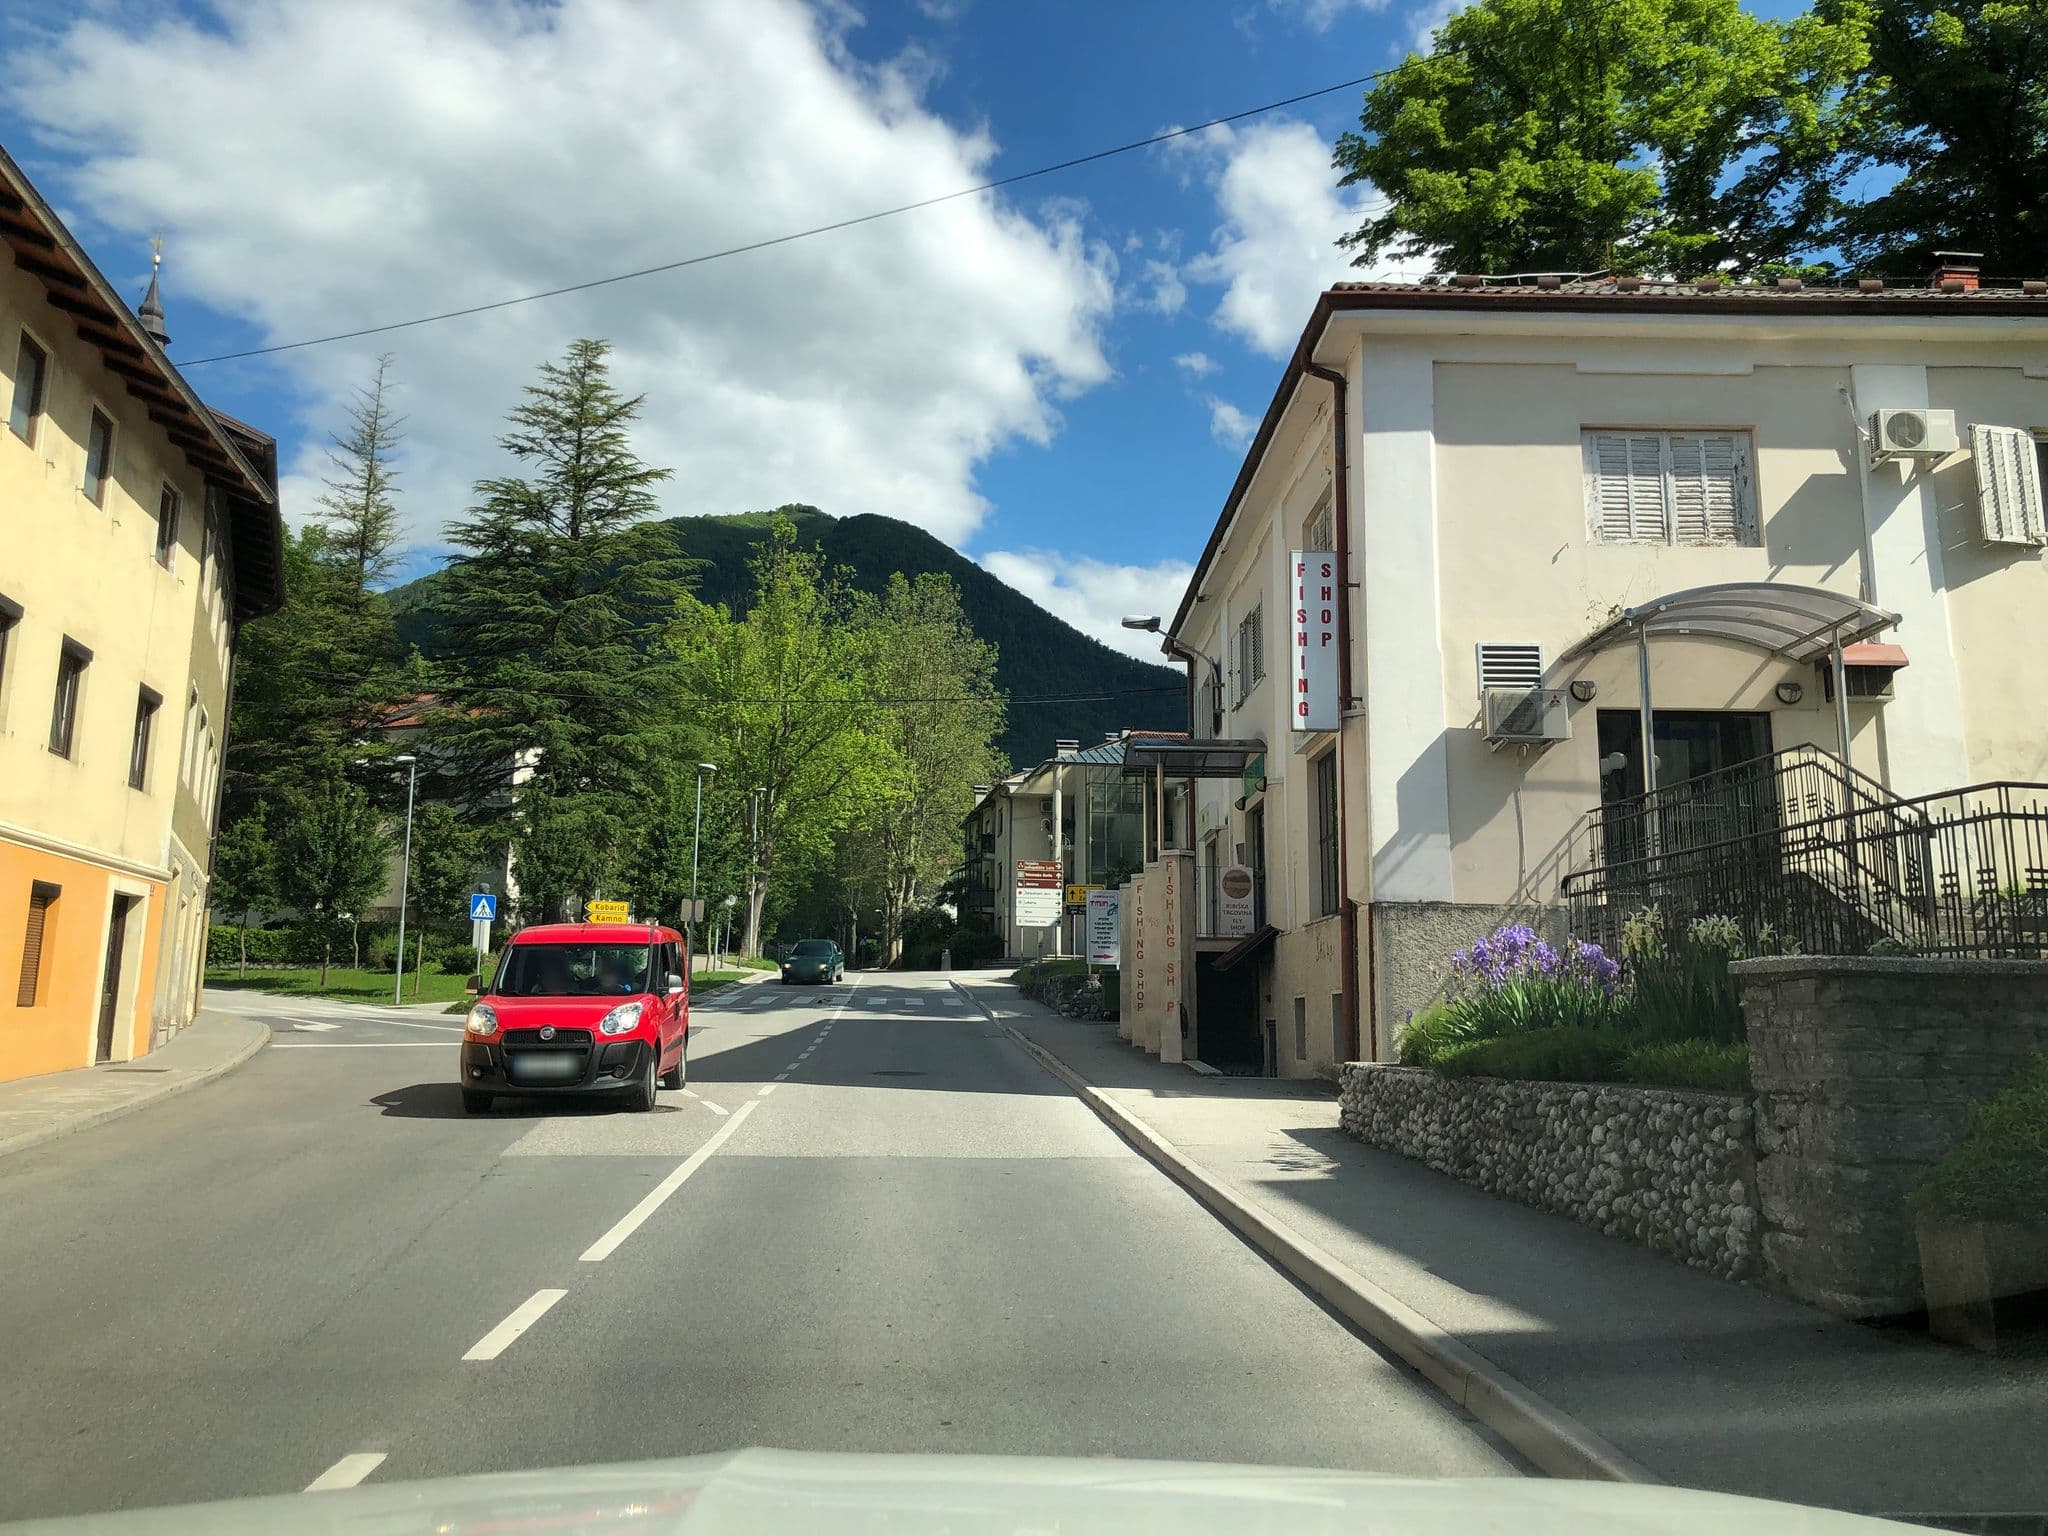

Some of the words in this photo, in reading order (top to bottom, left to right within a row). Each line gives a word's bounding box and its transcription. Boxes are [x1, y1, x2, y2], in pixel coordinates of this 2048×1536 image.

[1297, 563, 1309, 717] FISHING
[1321, 563, 1332, 647] SHOP
[595, 903, 625, 911] Kobarid
[1136, 884, 1144, 960] FISHING
[1165, 861, 1175, 948] FISHING
[1136, 969, 1145, 1012] SHOP
